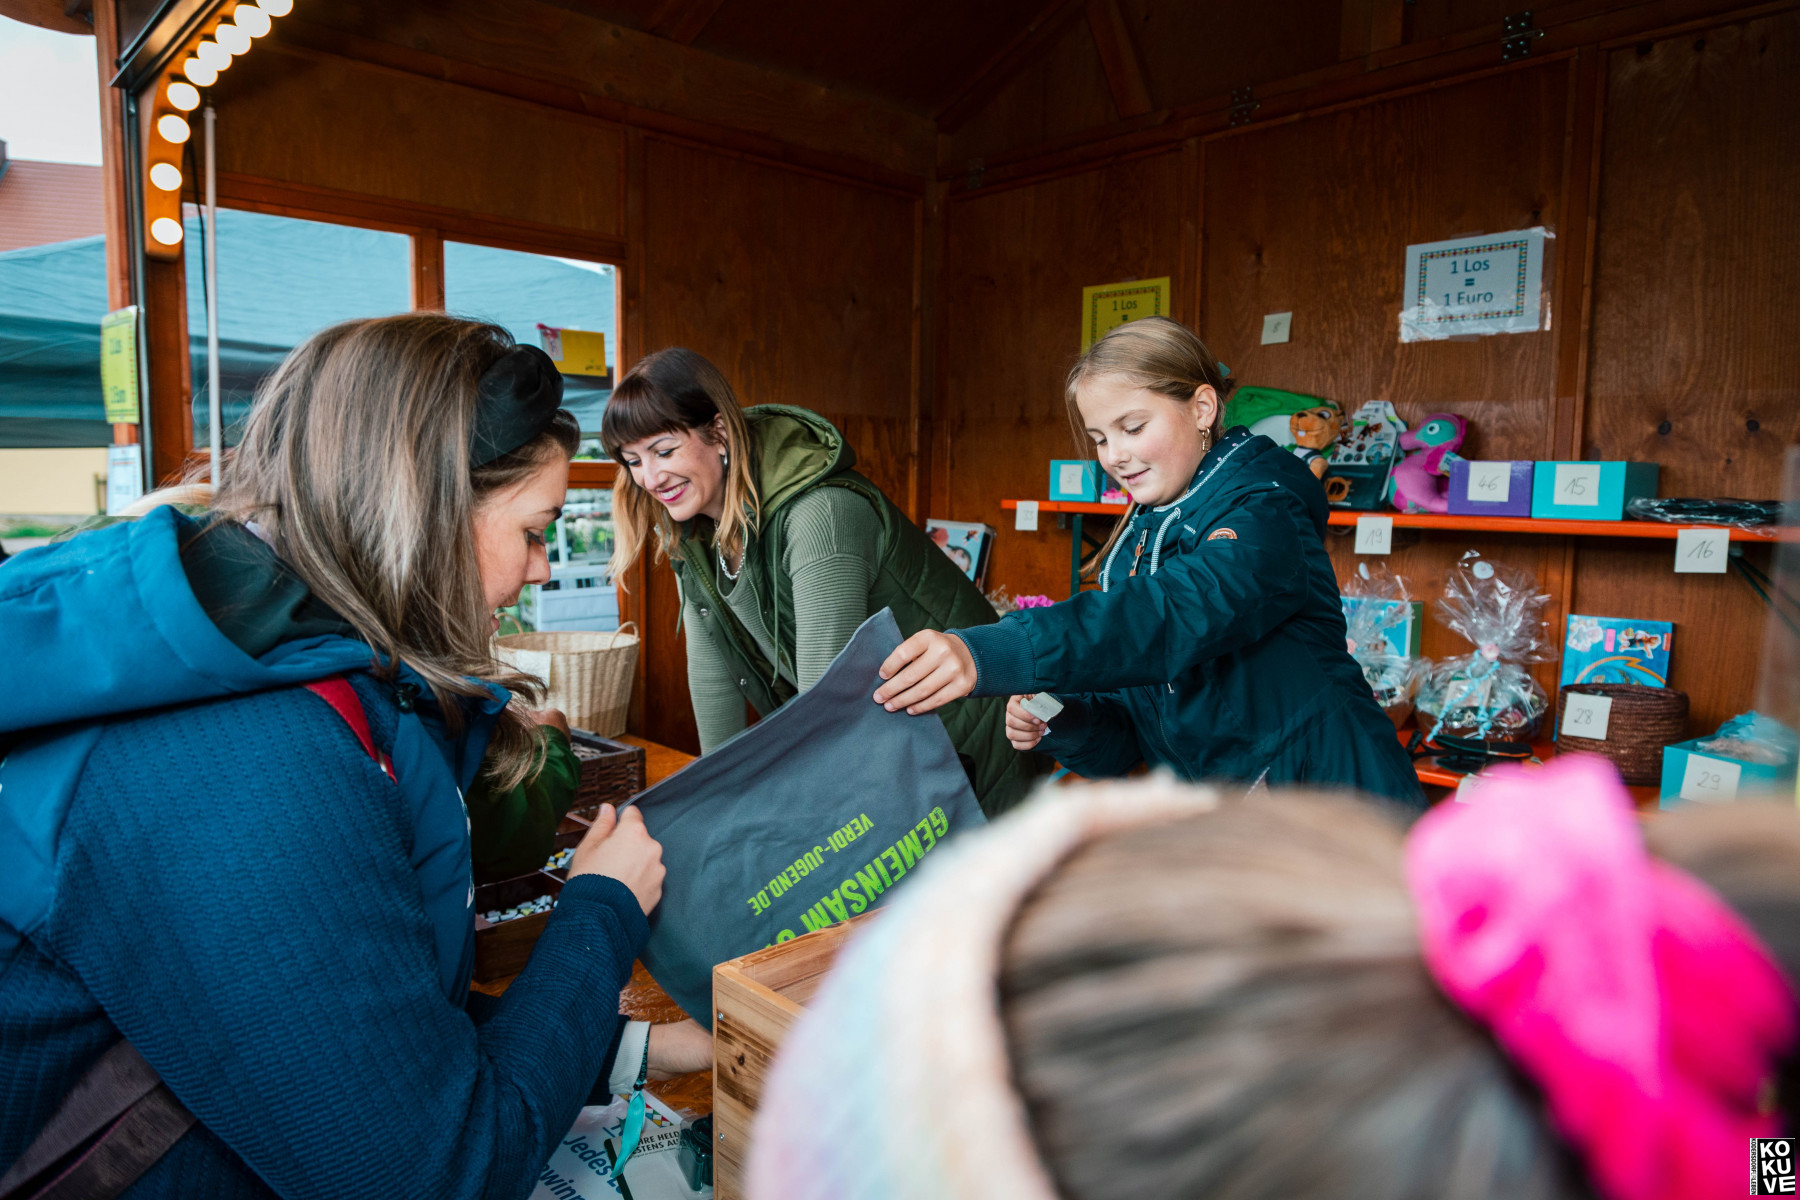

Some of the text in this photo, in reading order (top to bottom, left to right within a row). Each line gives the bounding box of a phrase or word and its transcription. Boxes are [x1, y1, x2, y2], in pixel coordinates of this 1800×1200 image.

[1450, 259, 1491, 275] 1 Los
[1121, 299, 1138, 311] Los
[1443, 291, 1494, 307] 1 Euro
[1477, 474, 1500, 491] 46
[1563, 476, 1589, 496] 15
[1364, 528, 1384, 546] 19
[1687, 540, 1715, 560] 16
[1573, 708, 1595, 725] 28
[1696, 771, 1722, 791] 29
[747, 813, 875, 916] VERDI-JUGEND.DE
[800, 806, 949, 933] GEMEINSAM
[563, 1135, 614, 1177] Jedes
